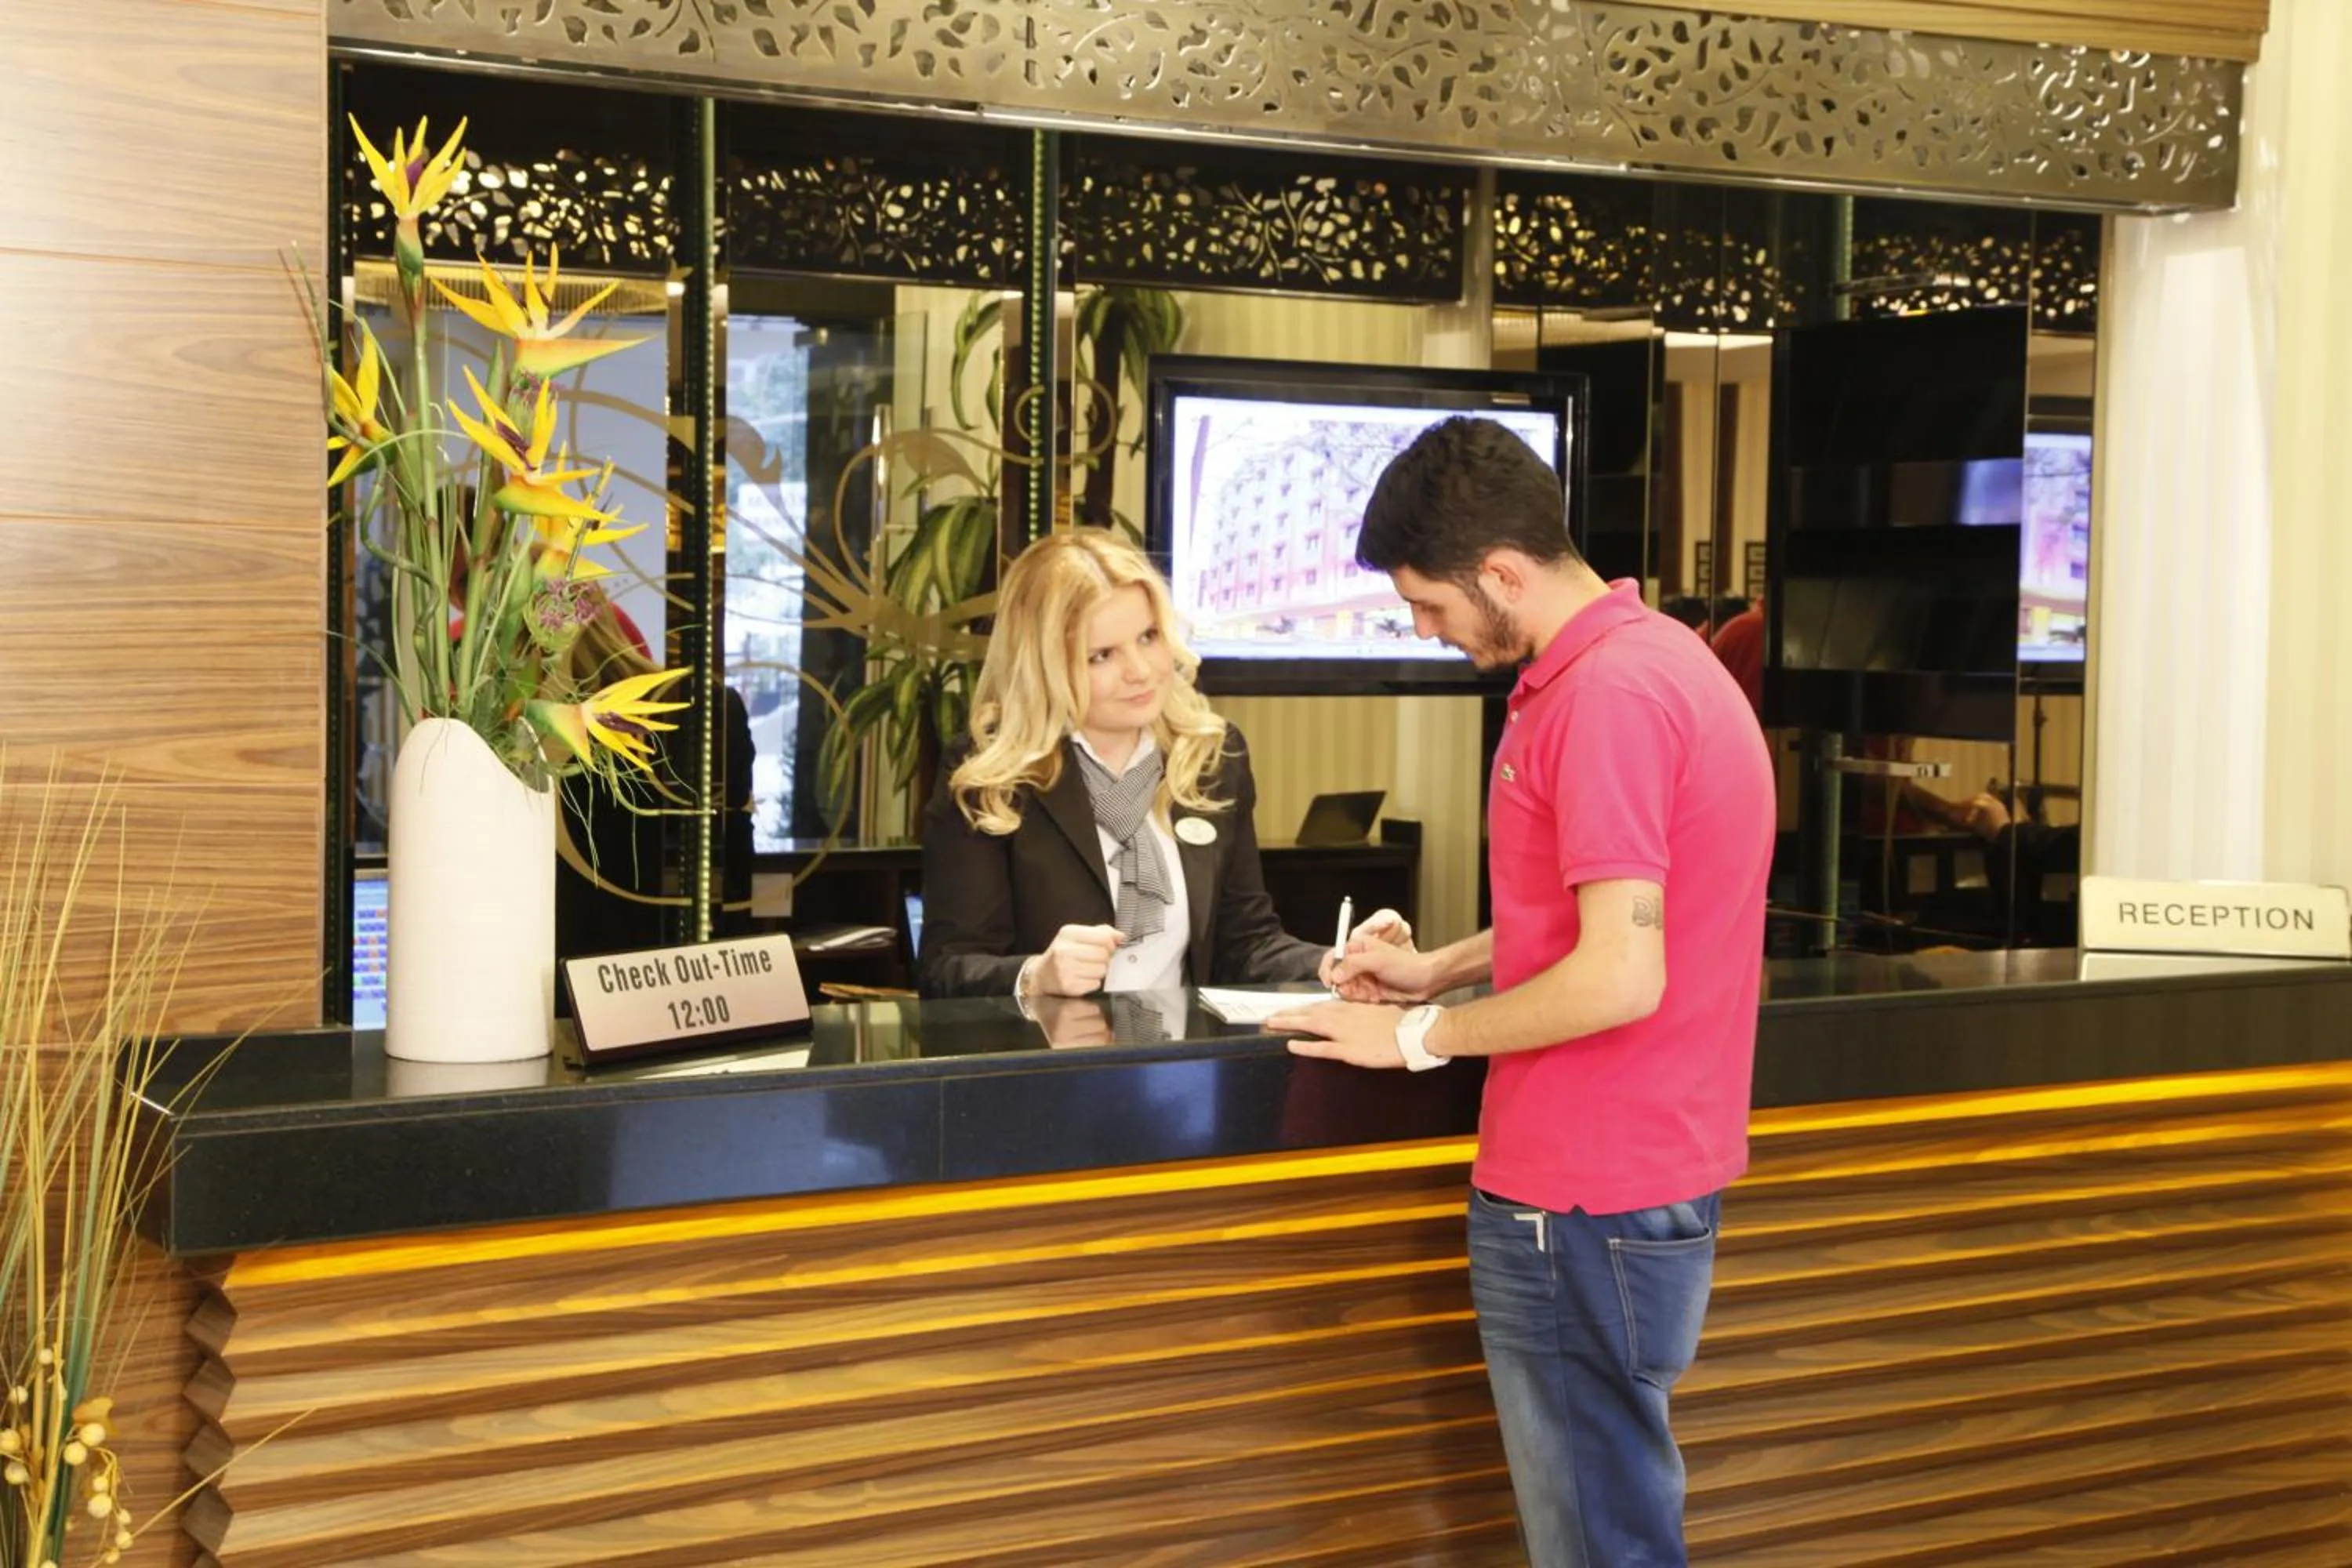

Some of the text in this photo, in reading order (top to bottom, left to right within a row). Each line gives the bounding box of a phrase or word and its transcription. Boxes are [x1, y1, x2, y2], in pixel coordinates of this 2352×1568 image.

[2118, 902, 2314, 931] RECEPTION
[597, 949, 772, 993] Check Out-Time
[668, 995, 730, 1030] 12:00
